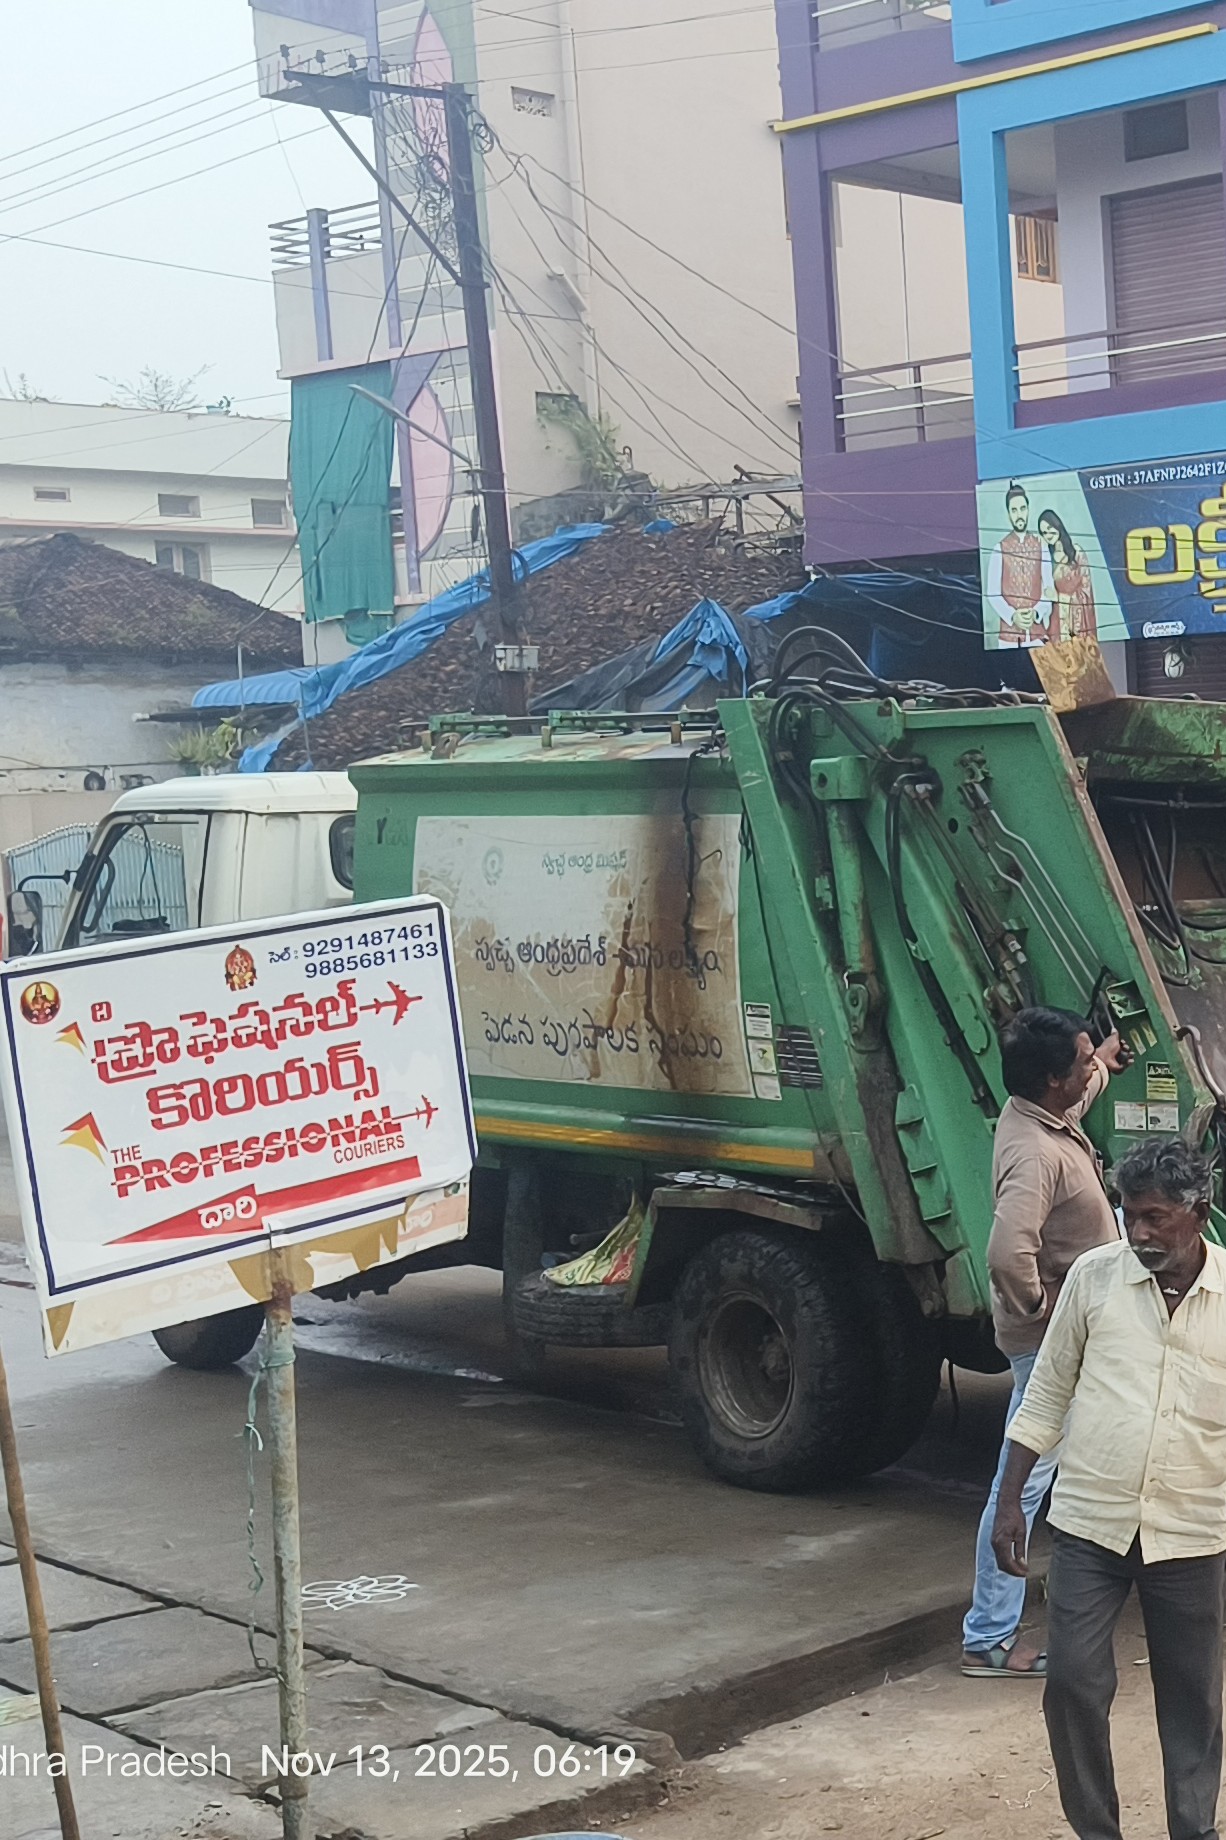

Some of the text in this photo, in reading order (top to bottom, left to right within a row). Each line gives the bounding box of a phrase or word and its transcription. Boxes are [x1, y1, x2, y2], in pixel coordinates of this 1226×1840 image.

[1090, 473, 1125, 489] GSTIN
[303, 923, 434, 957] 9291487461
[517, 934, 607, 976] ఆంధ్రప్రదేశ్
[305, 942, 439, 978] 9885681133
[481, 1011, 534, 1046] పెడన
[111, 1106, 402, 1197] PROFESSIONAL
[111, 1144, 142, 1163] THE
[334, 1136, 405, 1164] COURIERS
[198, 1192, 258, 1230] దారి
